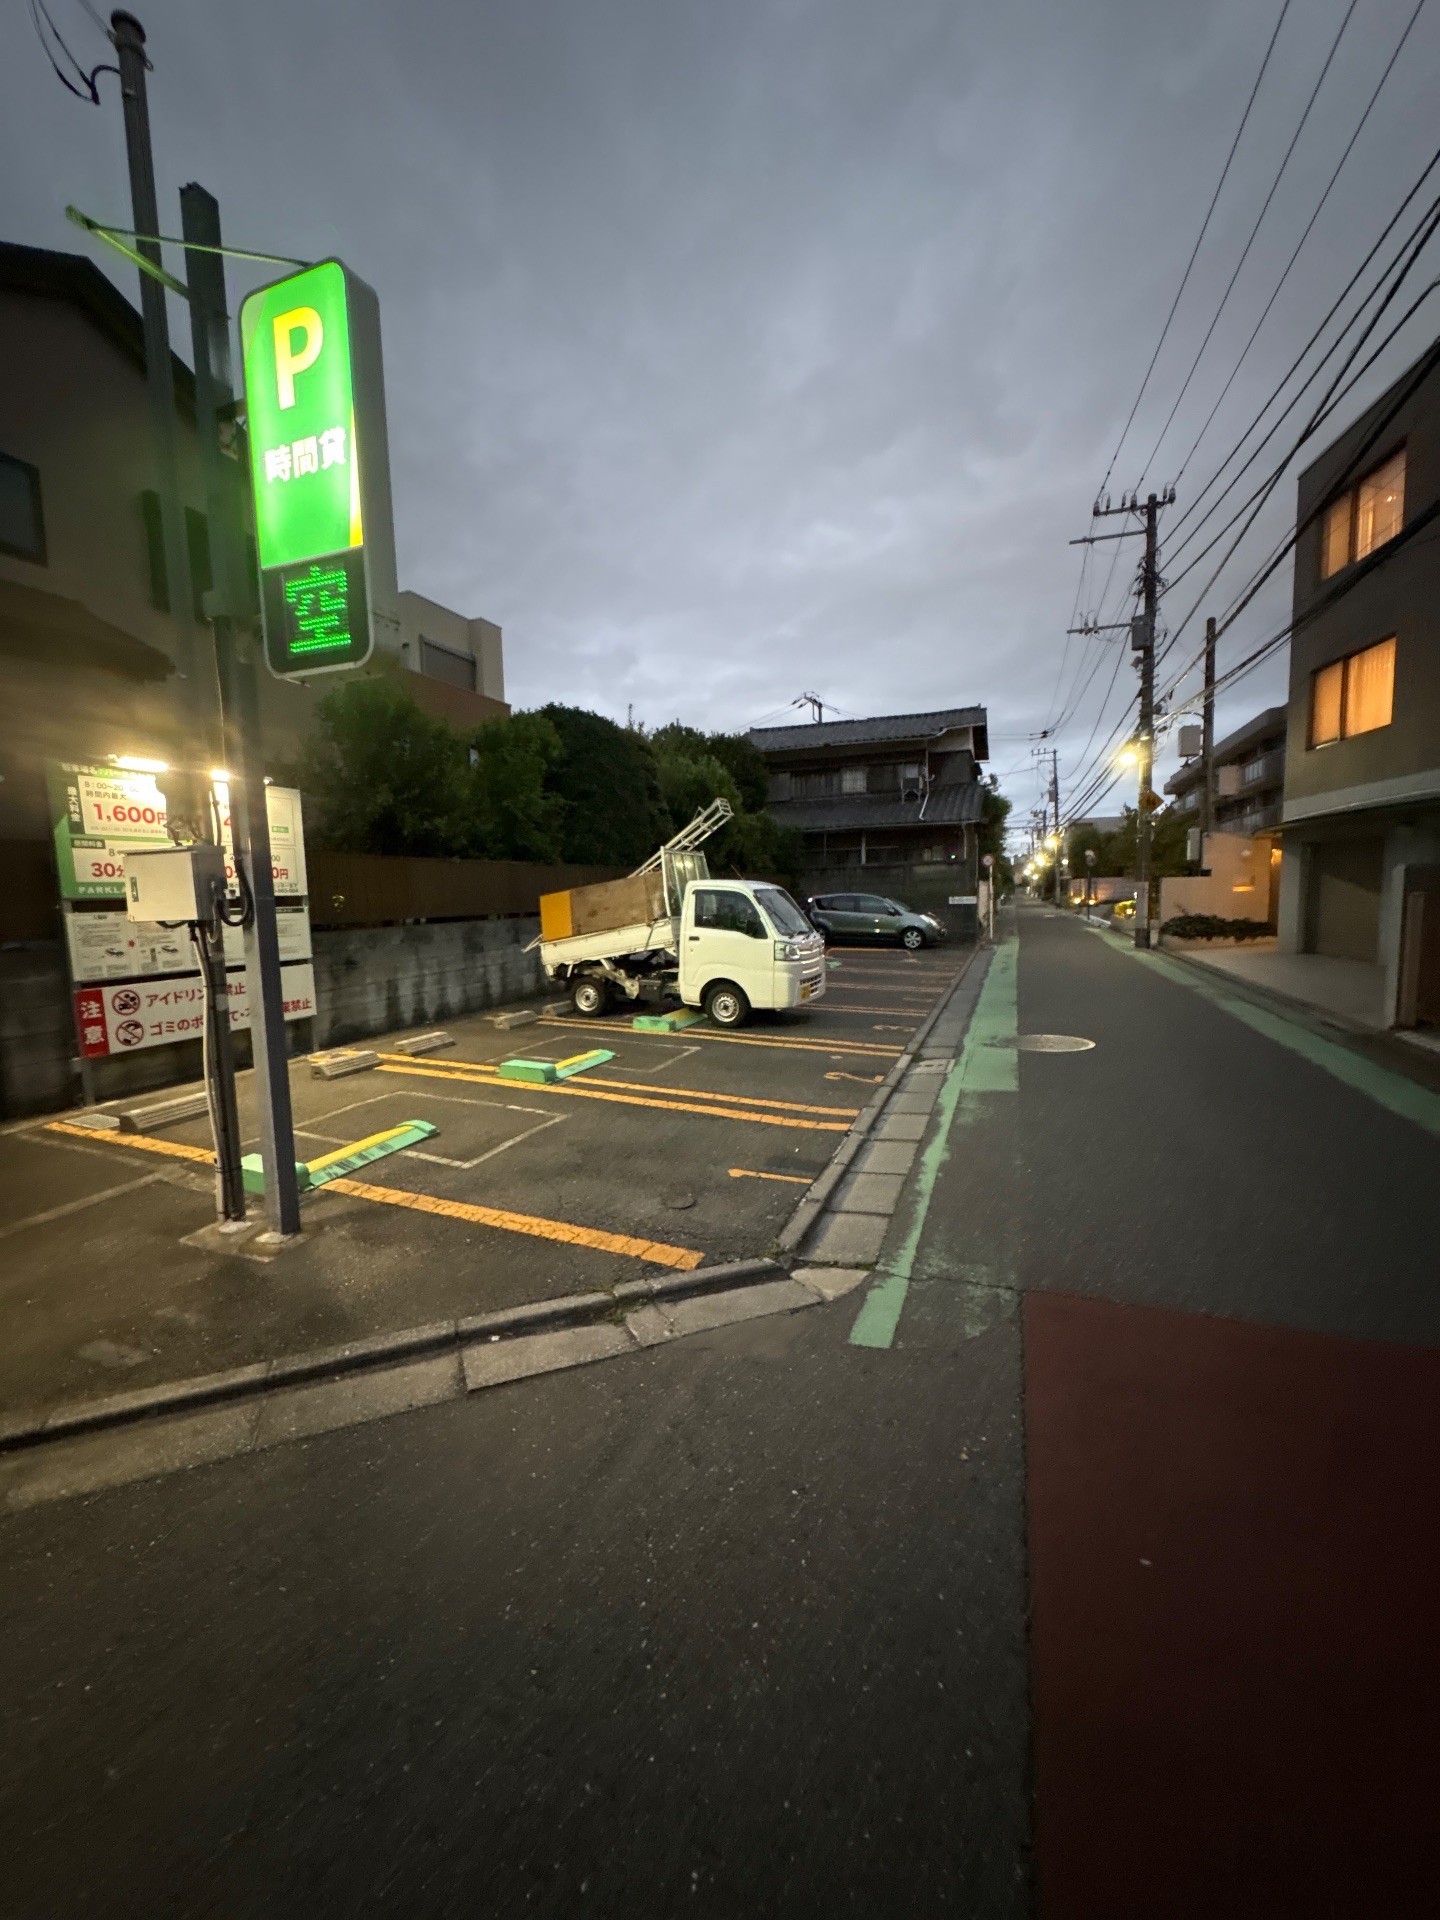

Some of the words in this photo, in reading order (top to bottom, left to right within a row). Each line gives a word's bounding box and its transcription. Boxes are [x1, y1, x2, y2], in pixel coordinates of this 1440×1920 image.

[273, 306, 324, 411] P
[264, 426, 347, 484] 時間貸
[285, 565, 351, 653] 空
[85, 790, 127, 801] 時間内最大
[93, 803, 167, 824] 1,600円
[81, 1001, 105, 1045] 注意
